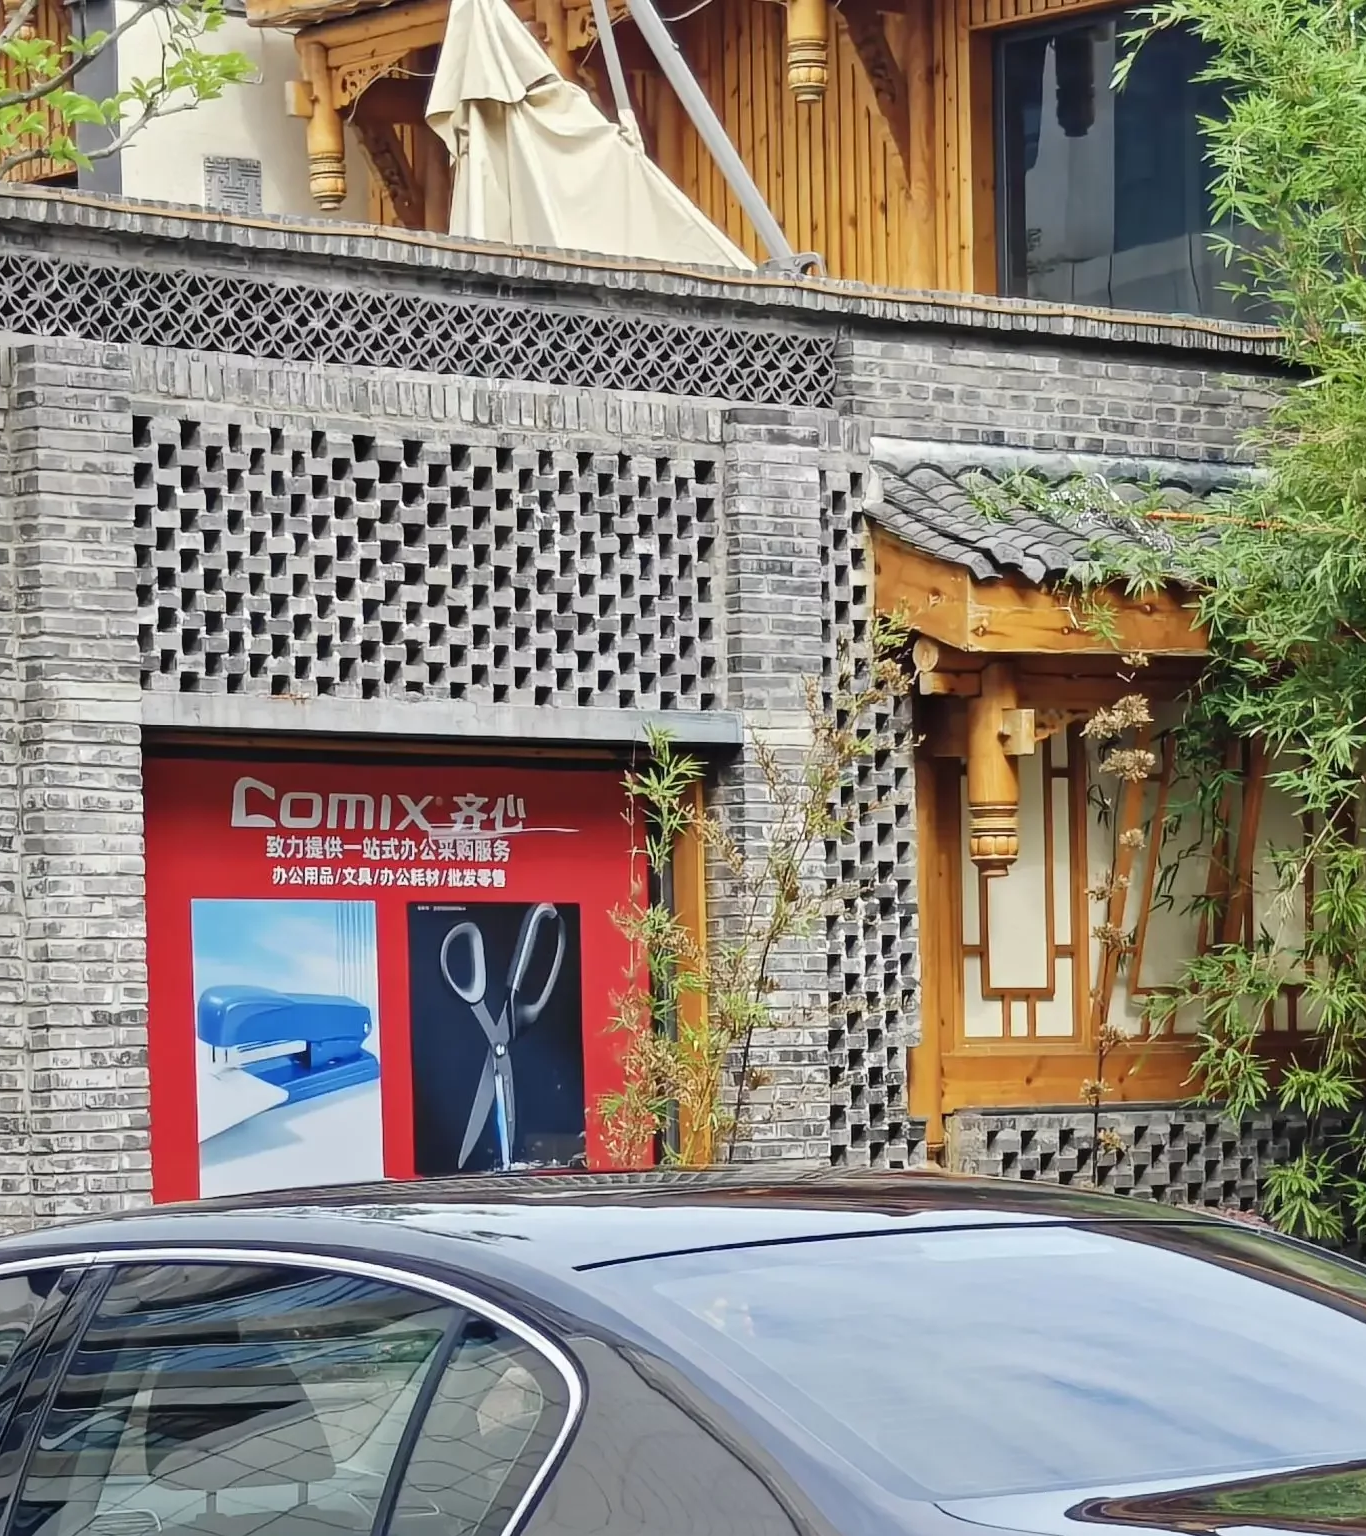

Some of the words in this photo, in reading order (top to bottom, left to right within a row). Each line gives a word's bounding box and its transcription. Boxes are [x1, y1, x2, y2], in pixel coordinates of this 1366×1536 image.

[266, 835, 511, 863] 致力提供一站式办公采购服务
